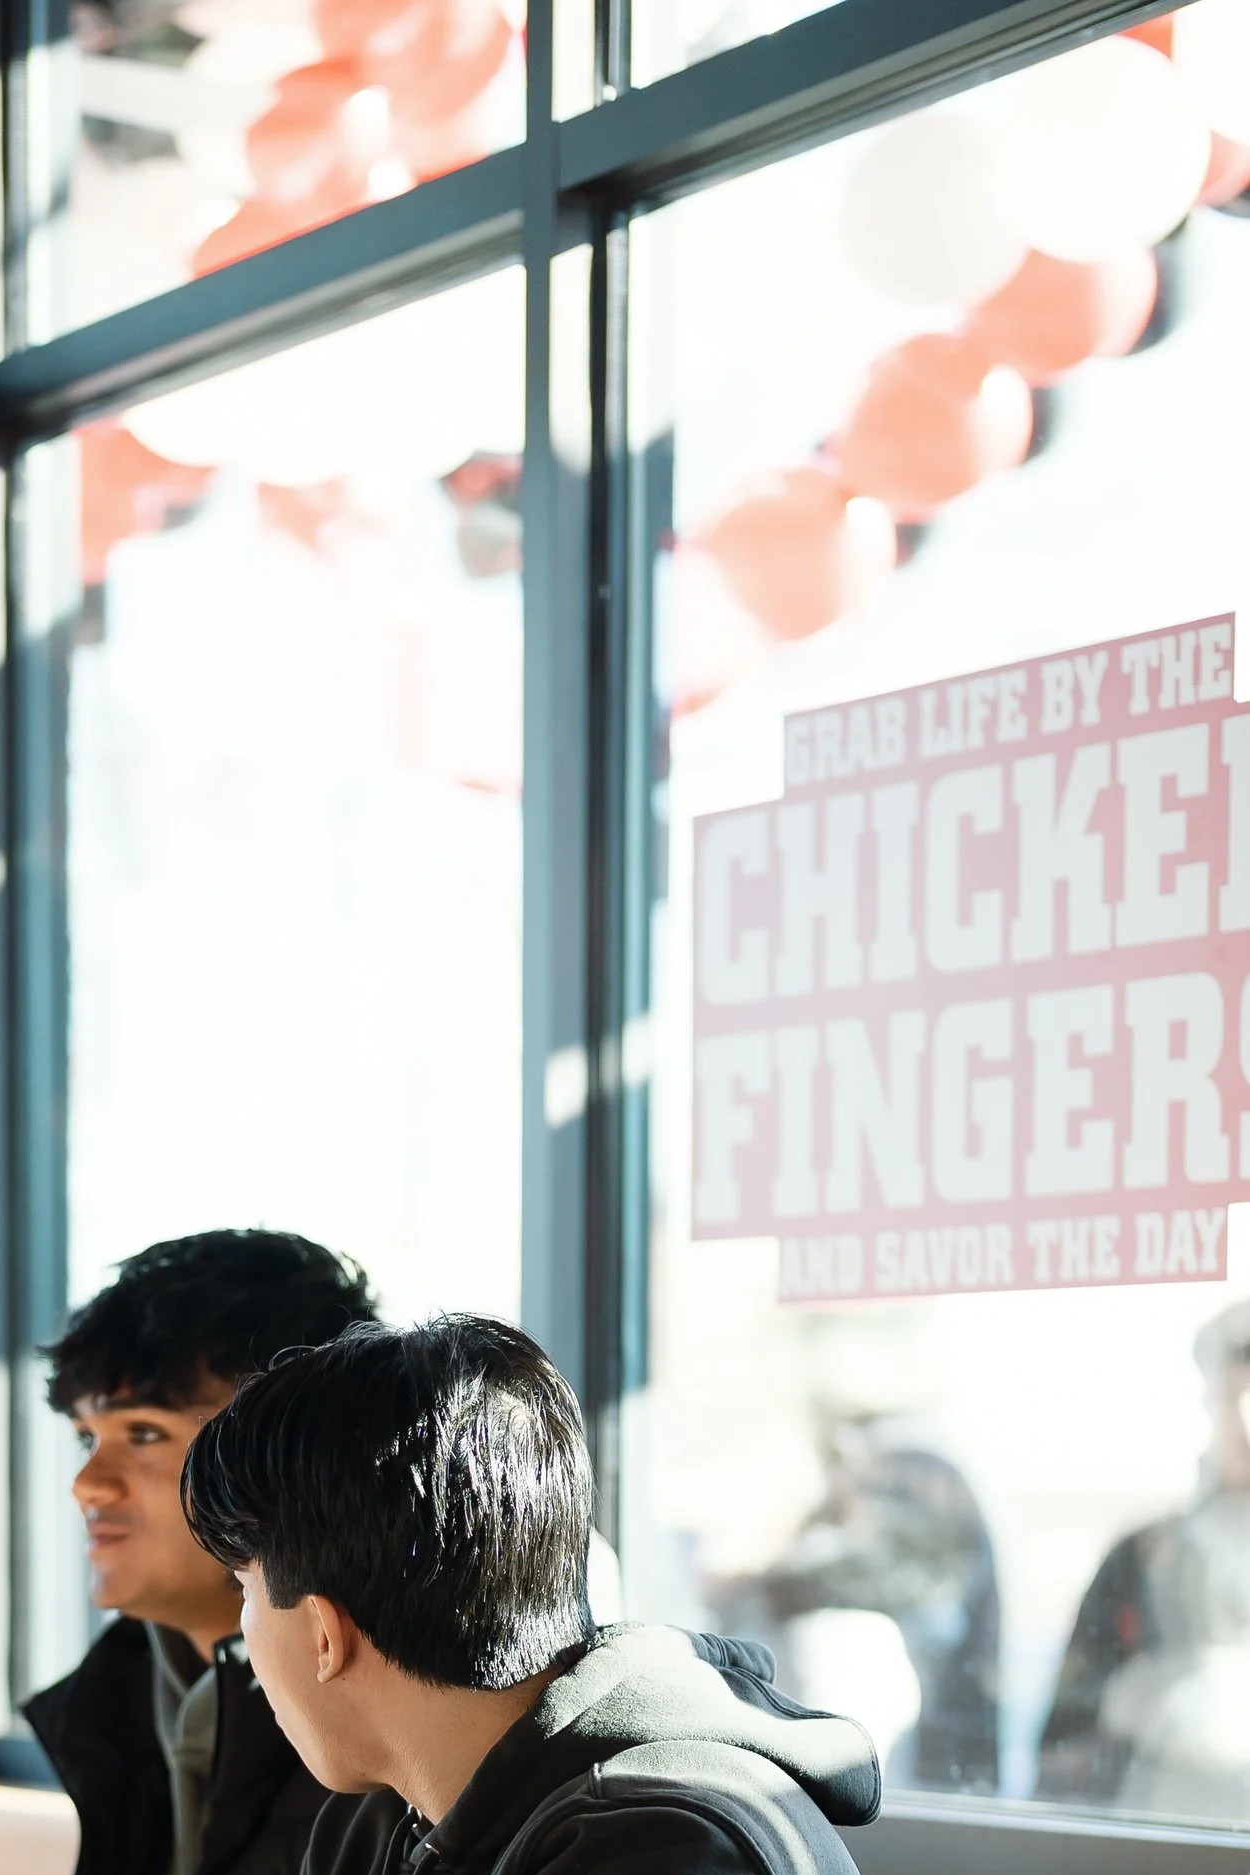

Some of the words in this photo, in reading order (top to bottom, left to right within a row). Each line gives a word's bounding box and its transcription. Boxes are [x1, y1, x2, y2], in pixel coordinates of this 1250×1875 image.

[786, 697, 906, 785] GRAB
[920, 669, 1027, 759] LIFE
[1041, 651, 1108, 734] BY
[1122, 623, 1232, 716] THE
[695, 970, 1250, 1224] FINGER
[780, 1214, 863, 1296] AND
[875, 1224, 1014, 1290] SAVOR
[1028, 1215, 1121, 1282] THE
[1134, 1209, 1226, 1275] DAY
